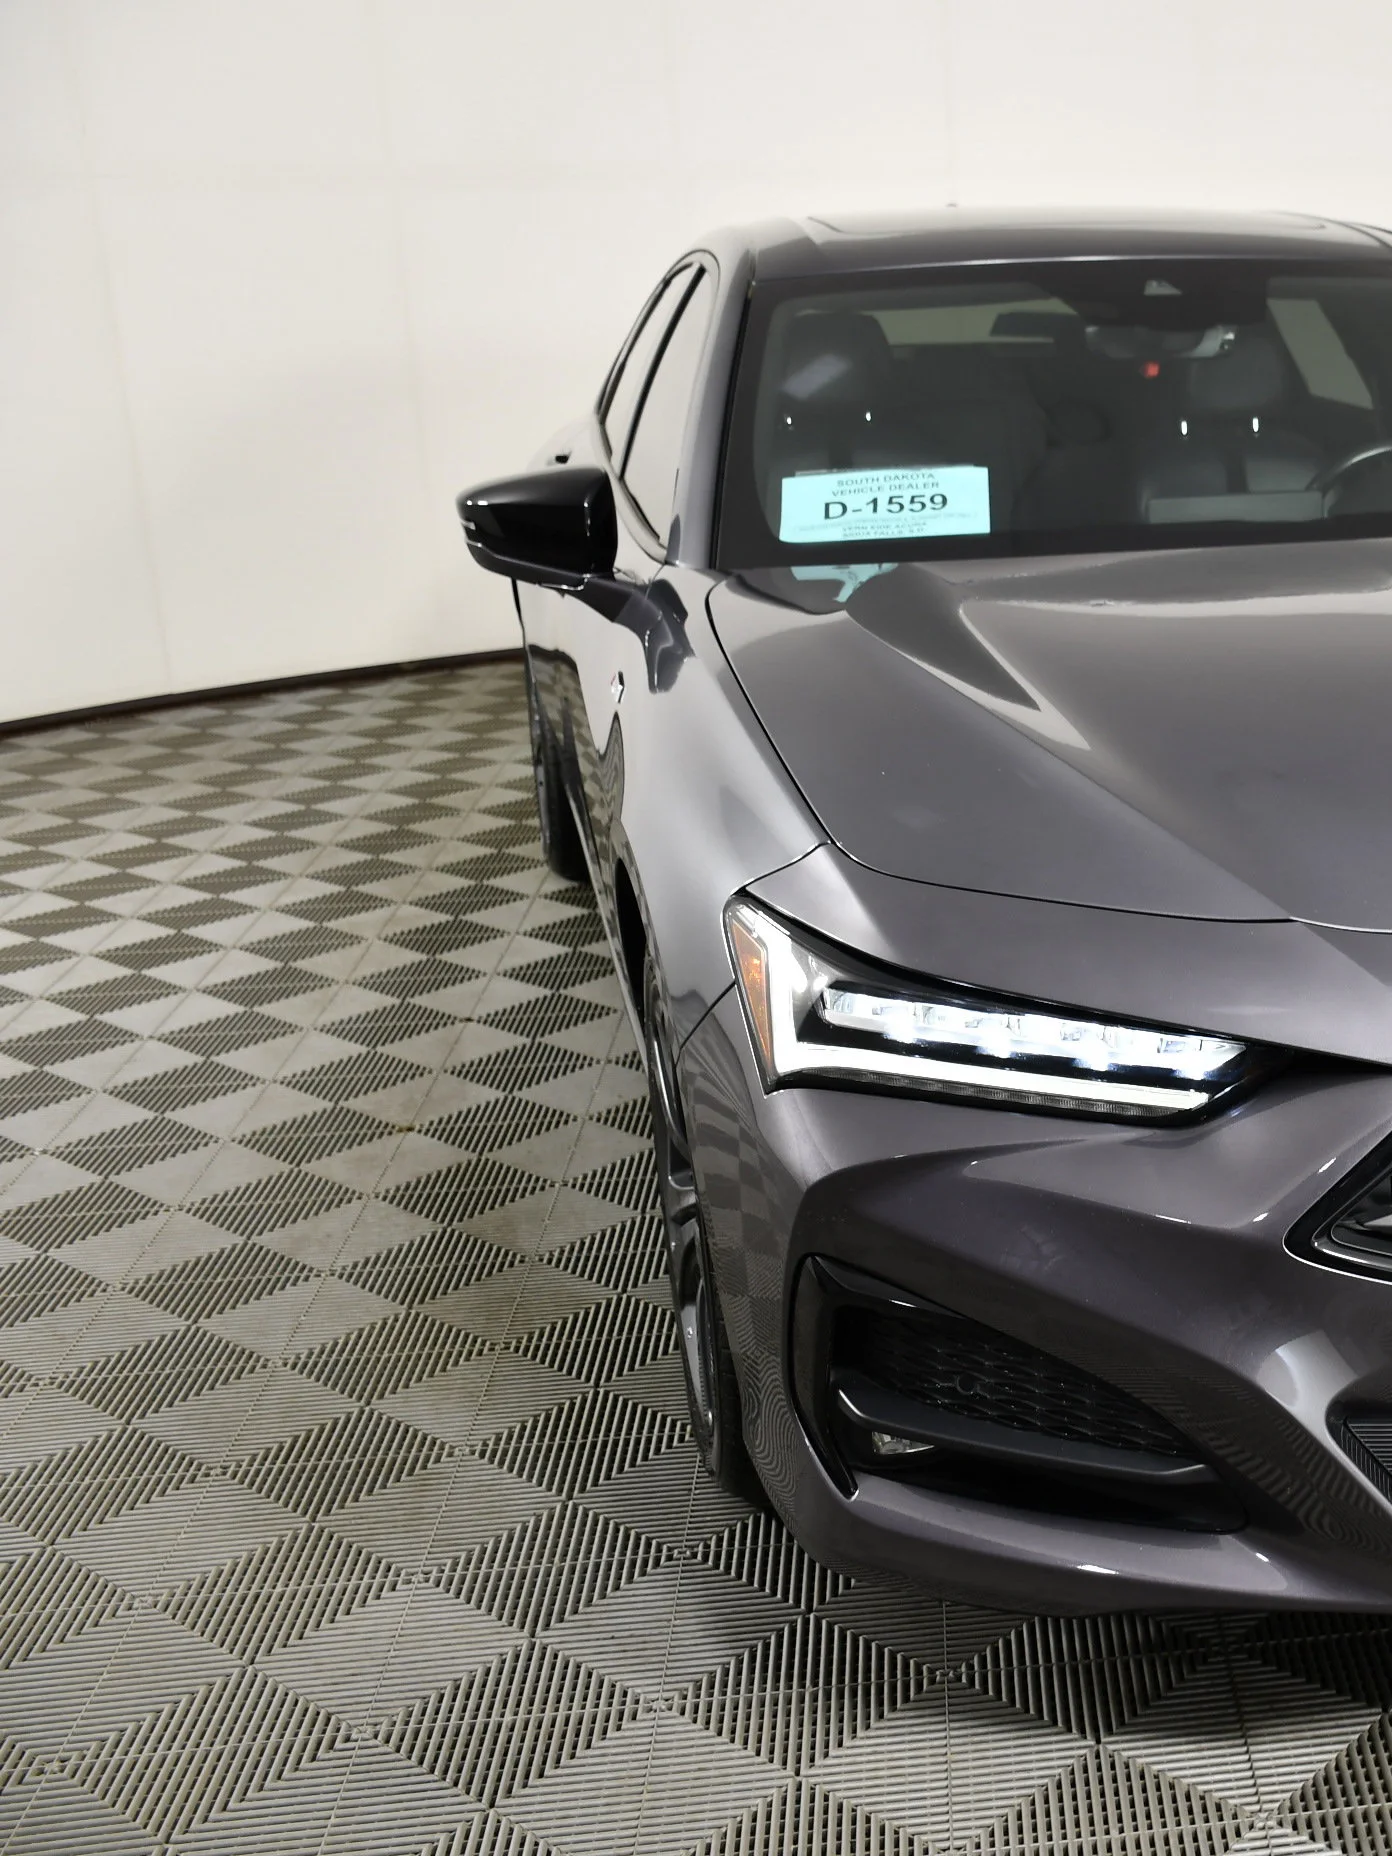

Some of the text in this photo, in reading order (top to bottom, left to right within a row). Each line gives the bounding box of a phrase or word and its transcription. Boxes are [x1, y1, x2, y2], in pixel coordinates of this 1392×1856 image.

[836, 472, 936, 488] SOUTH DAKOTA
[831, 481, 940, 497] VEHICLE DEALER
[823, 492, 948, 520] D-1559
